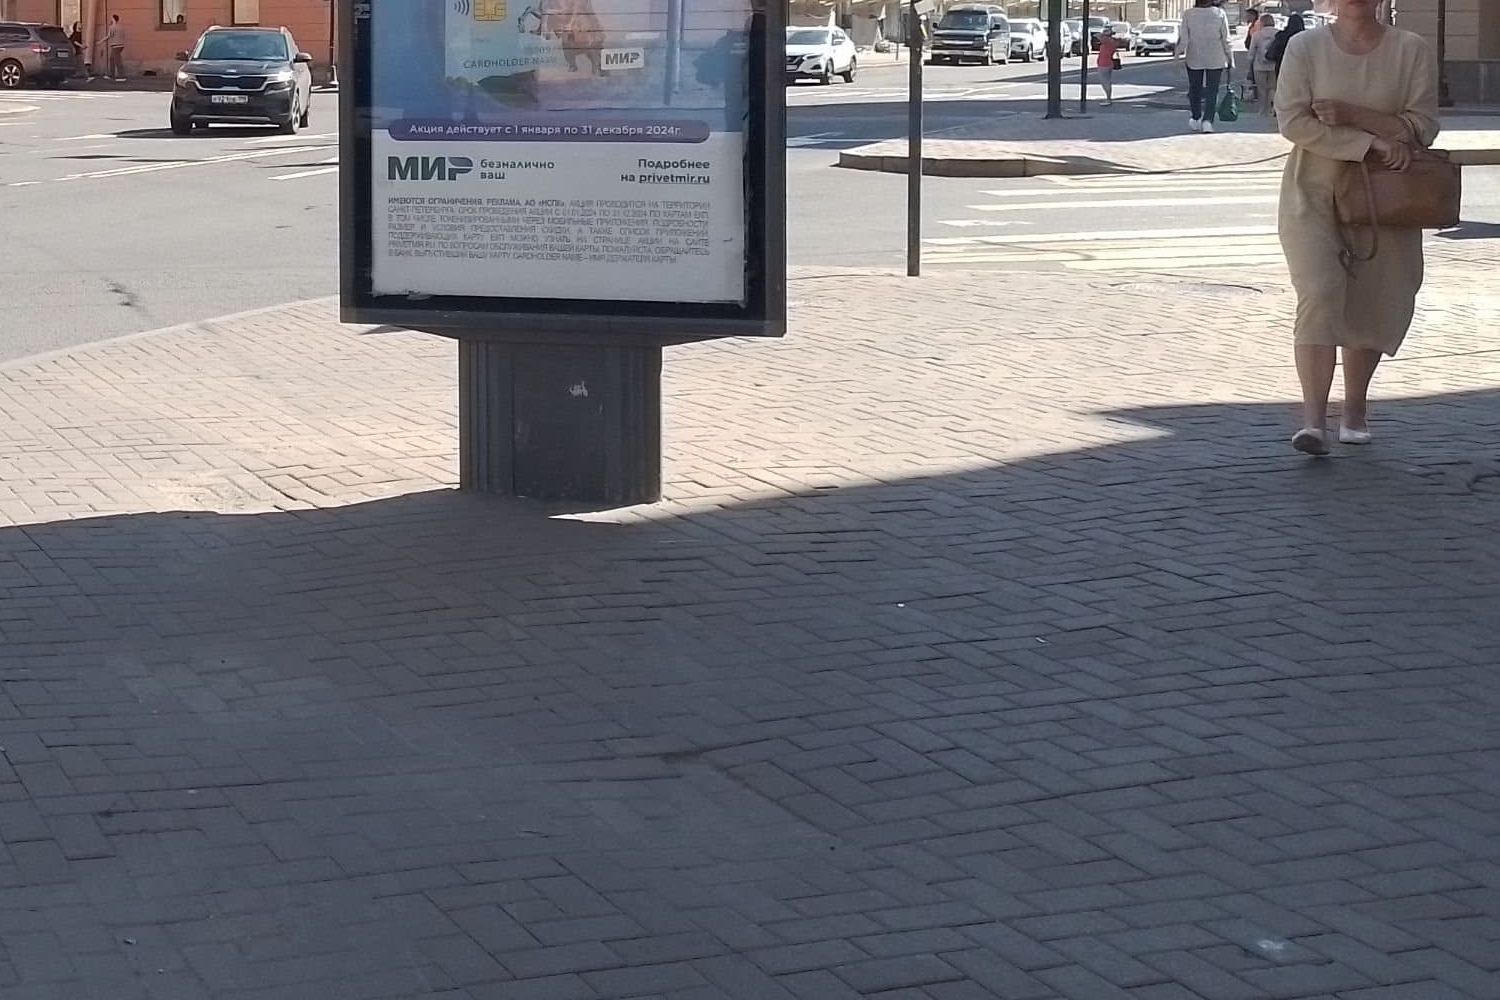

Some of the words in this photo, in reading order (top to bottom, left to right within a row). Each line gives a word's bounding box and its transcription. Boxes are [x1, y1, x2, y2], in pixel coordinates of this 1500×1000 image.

[463, 56, 531, 69] CARDHOLDER
[605, 52, 641, 66] МИР
[410, 124, 444, 134] Акция
[446, 125, 502, 136] действует
[522, 126, 561, 136] января
[564, 127, 578, 135] по
[581, 125, 592, 135] 31
[595, 125, 643, 137] декабря
[388, 156, 474, 181] МИР
[480, 159, 555, 169] безналично
[638, 158, 710, 170] Подробнее
[480, 172, 505, 180] ваш
[621, 174, 635, 182] на
[639, 173, 710, 185] privetmir.ru
